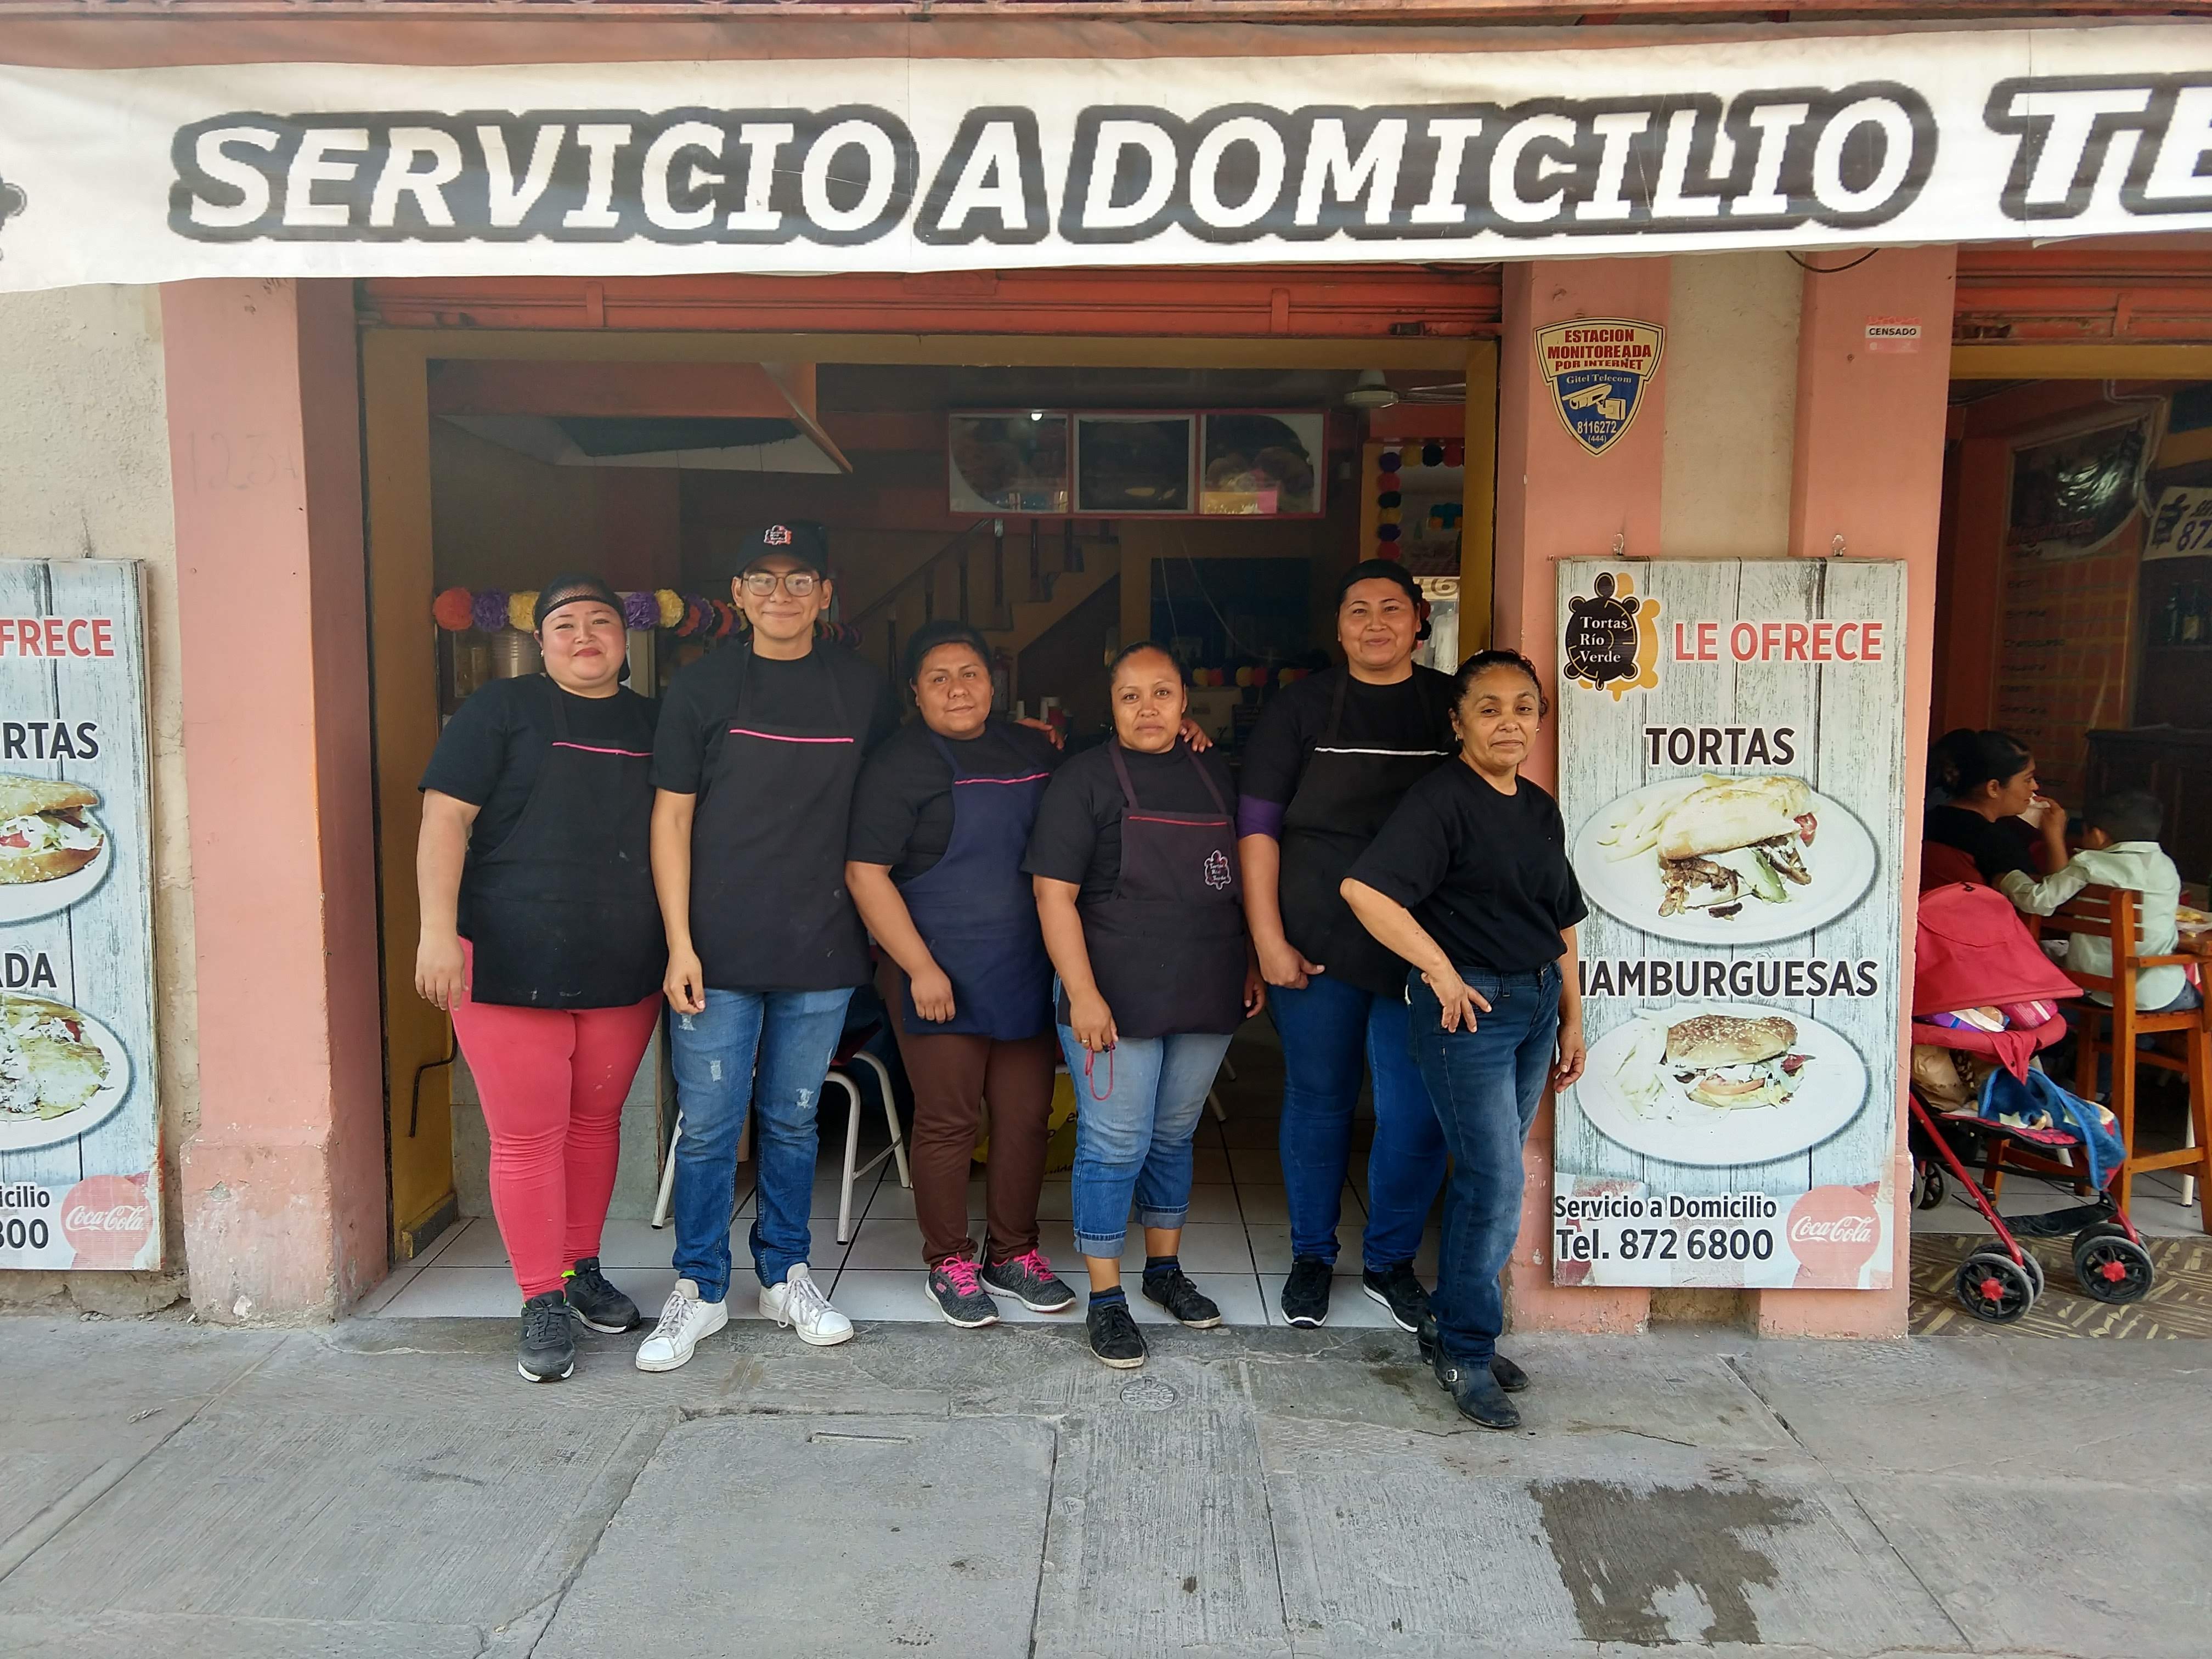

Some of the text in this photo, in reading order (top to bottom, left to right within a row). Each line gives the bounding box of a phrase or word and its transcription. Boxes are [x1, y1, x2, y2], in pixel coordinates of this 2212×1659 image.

[179, 114, 908, 238] SERVICIO
[925, 113, 1039, 237] A
[1070, 89, 1923, 237] DOMICILIO
[1565, 329, 1634, 343] ESTACION
[1869, 328, 1917, 336] CENSADO
[1548, 345, 1651, 359] MONITOREADA
[1555, 359, 1644, 371] POR INTERNET
[1566, 374, 1632, 383] Gitel Telecom
[1577, 421, 1617, 433] 8116272
[1580, 616, 1628, 629] Tortas
[1580, 633, 1605, 645] Río
[1675, 622, 1883, 661] LE OFRECE
[1580, 650, 1621, 663] Verde
[2, 722, 99, 759] RTAS
[1645, 727, 1795, 765] TORTAS
[0, 952, 57, 988] DA
[66, 1205, 148, 1231] Coca-Cola
[1554, 1195, 1777, 1218] Servicio a Domicilio
[0, 1218, 49, 1249] 00
[1791, 1215, 1875, 1243] Coca-Cola
[1556, 1228, 1774, 1260] Tel. 872 6800
